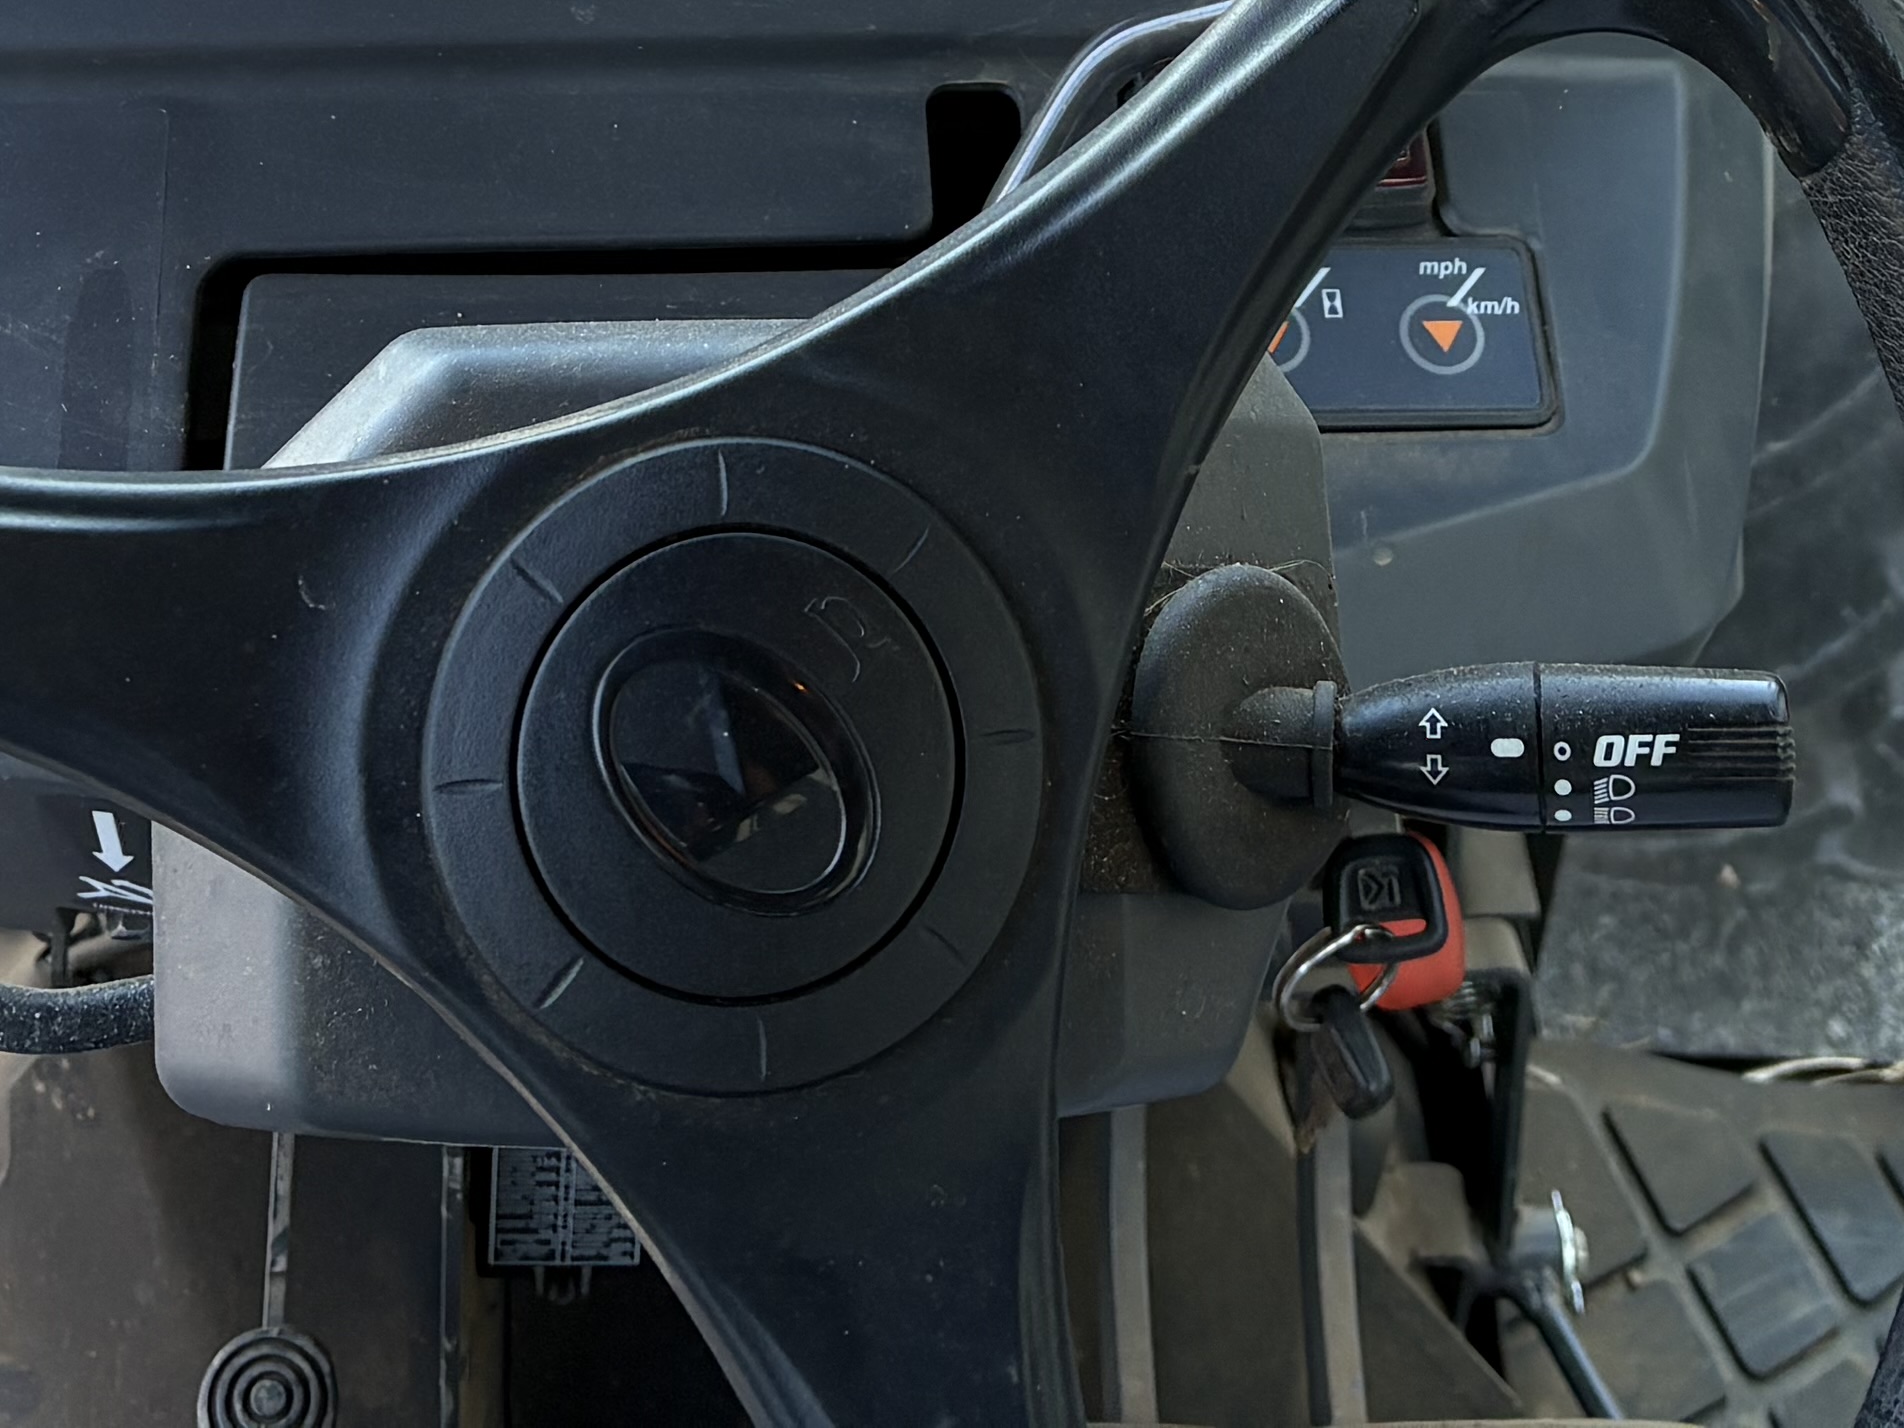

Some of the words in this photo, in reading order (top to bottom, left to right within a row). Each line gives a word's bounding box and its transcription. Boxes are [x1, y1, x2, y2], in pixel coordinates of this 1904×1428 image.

[1419, 257, 1467, 279] mph
[1467, 296, 1520, 315] km/h
[1593, 733, 1681, 767] OFF
